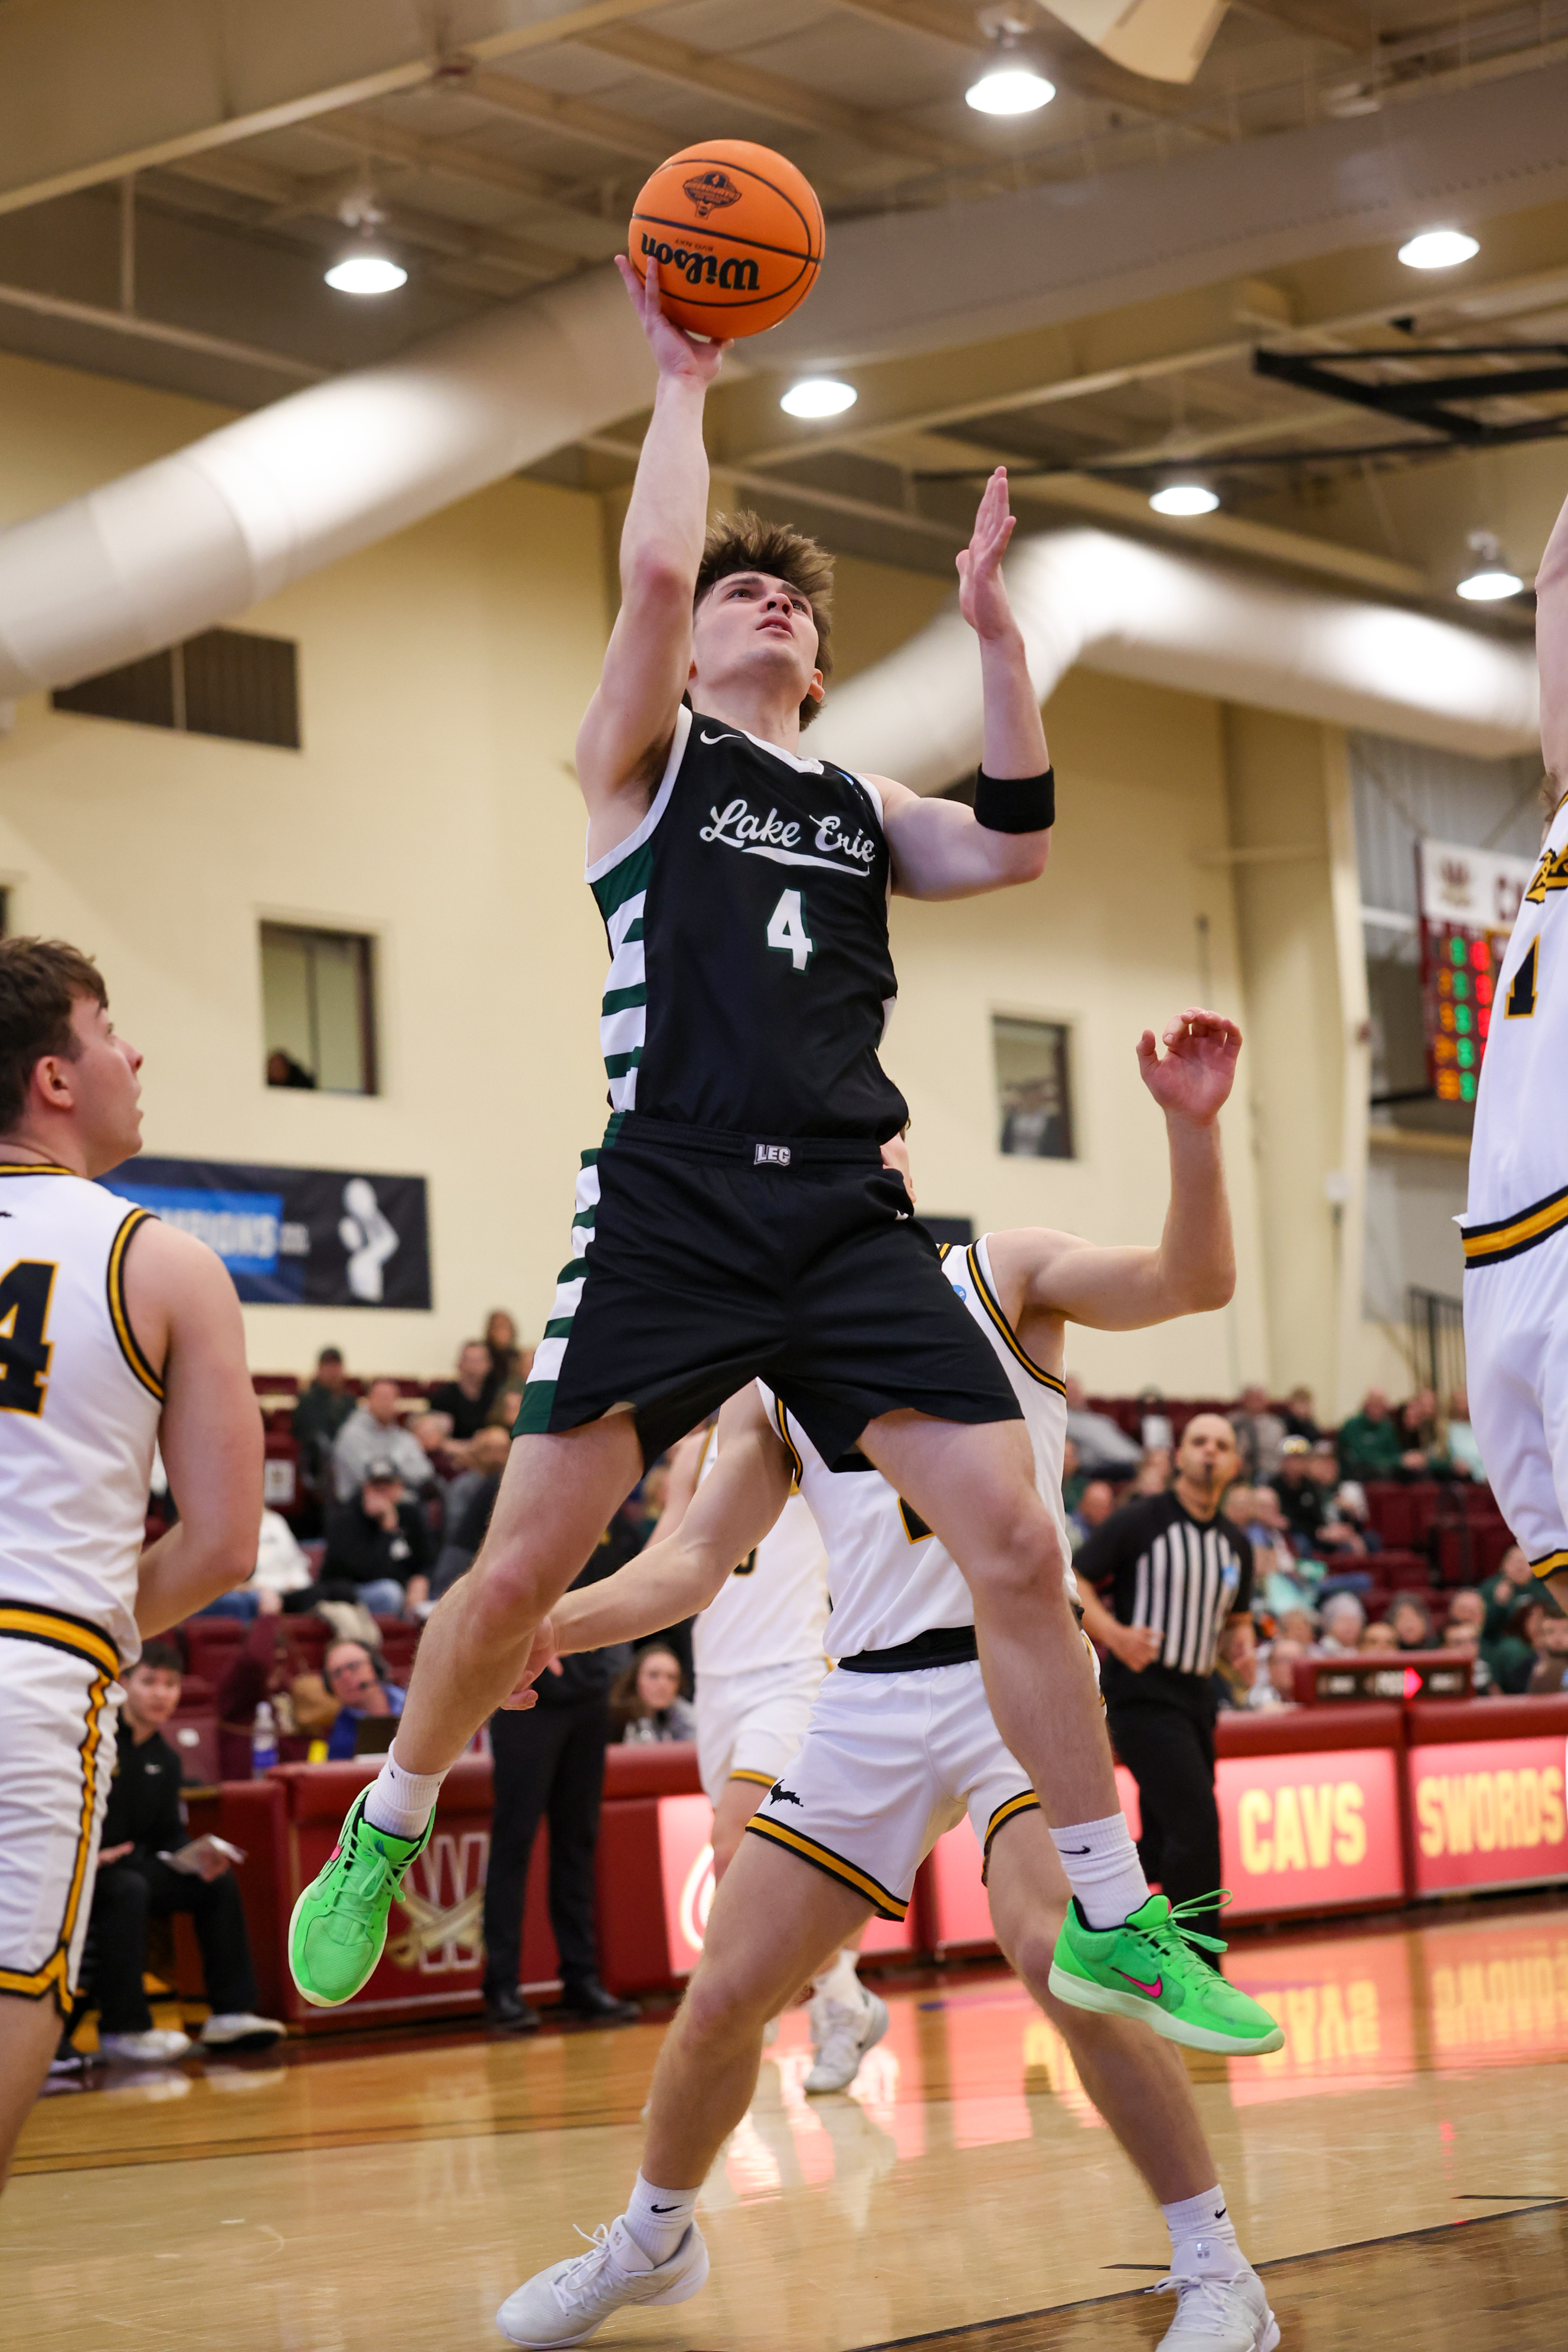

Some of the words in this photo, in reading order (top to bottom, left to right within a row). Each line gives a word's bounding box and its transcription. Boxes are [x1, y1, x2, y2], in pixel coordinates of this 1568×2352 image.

[641, 233, 760, 290] Wilson
[700, 799, 801, 848] Lake
[809, 815, 876, 863] Erie
[766, 887, 815, 975] 4
[1239, 1781, 1366, 1875] CAVS
[1417, 1766, 1566, 1857] SWORDS
